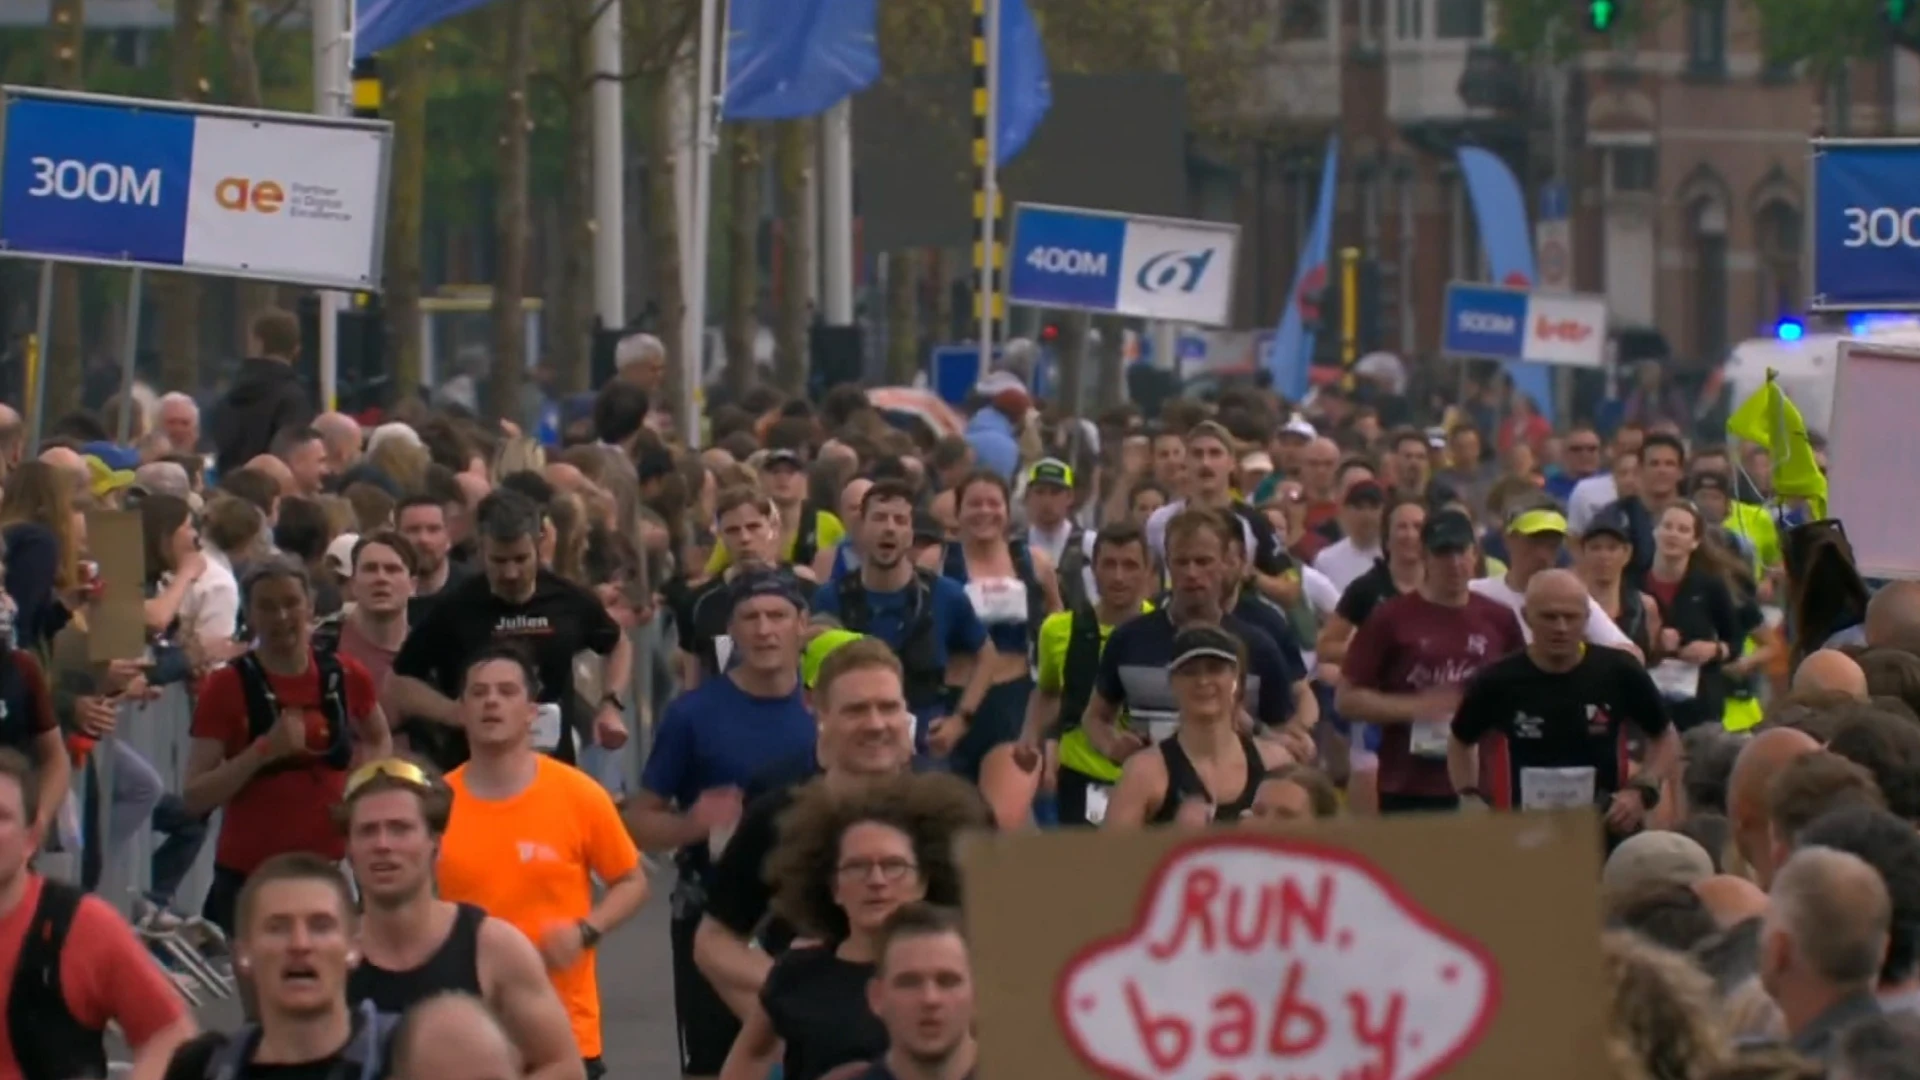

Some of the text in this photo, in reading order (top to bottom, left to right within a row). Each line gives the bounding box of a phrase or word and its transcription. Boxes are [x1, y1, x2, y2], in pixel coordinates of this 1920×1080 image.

[28, 156, 162, 207] 300M
[214, 176, 284, 214] ae
[1026, 246, 1108, 277] 400M
